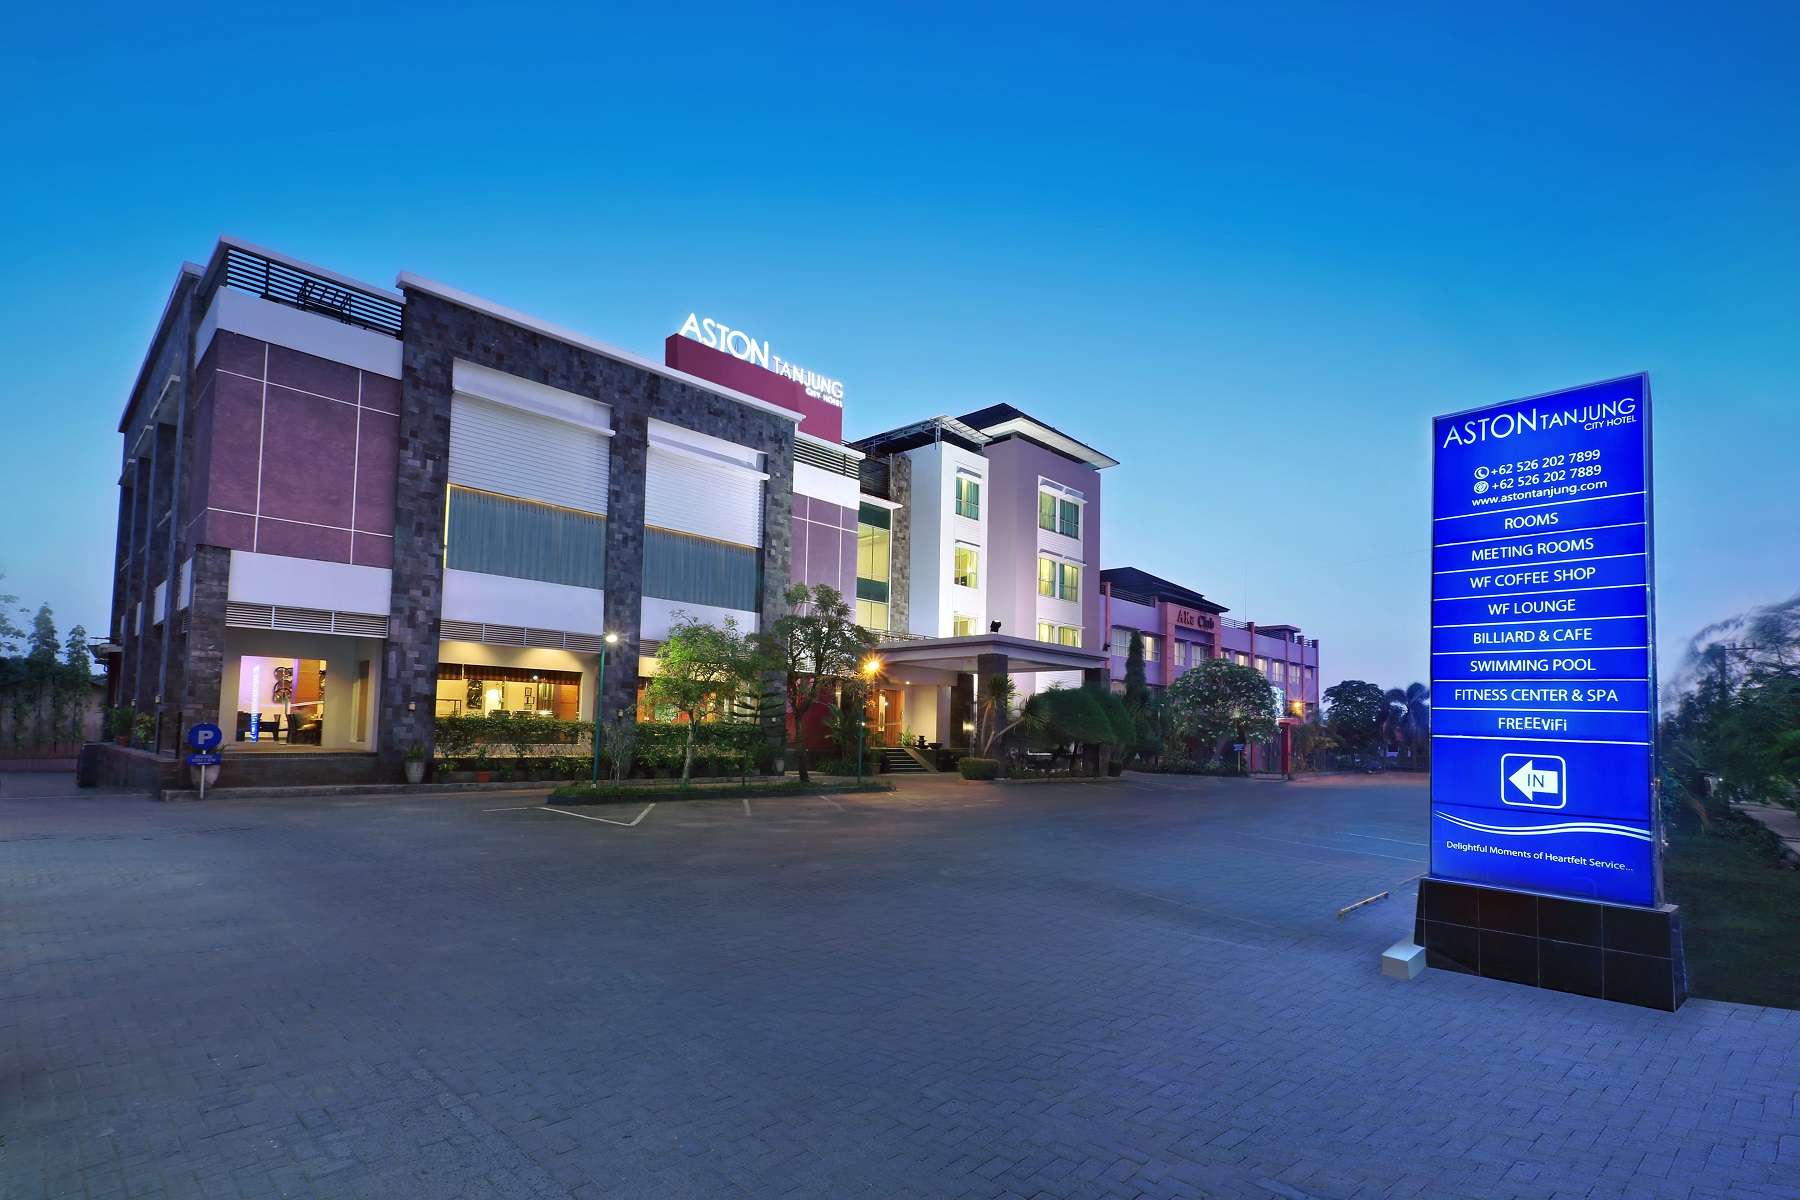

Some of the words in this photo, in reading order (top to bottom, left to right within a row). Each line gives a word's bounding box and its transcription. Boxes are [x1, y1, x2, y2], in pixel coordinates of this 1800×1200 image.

[679, 312, 769, 369] ASTON
[772, 355, 844, 398] TANJUNG
[1443, 408, 1537, 449] ASTON
[1539, 397, 1636, 431] TANJUNG
[1583, 420, 1605, 431] CITY
[1606, 414, 1637, 427] HOTEL
[1491, 463, 1513, 476] +62
[1517, 459, 1539, 472] 526
[1542, 454, 1565, 468] 202
[1569, 449, 1601, 464] 7899
[1492, 478, 1514, 491] +62
[1518, 473, 1540, 487] 526
[1543, 469, 1566, 483] 202
[1570, 464, 1602, 479] 7889
[1471, 479, 1608, 507] www.astontanjung.com
[1504, 512, 1559, 530] ROOMS
[1471, 544, 1534, 562] MEETING
[1537, 537, 1594, 554] ROOMS
[1470, 576, 1492, 589] WF
[1495, 571, 1549, 588] COFFEE
[1553, 567, 1596, 582] SHOP
[1488, 603, 1510, 616] WF
[1514, 599, 1576, 615] LOUNGE
[1473, 630, 1535, 644] BILLIARD
[1538, 629, 1550, 642] &
[1553, 628, 1593, 641] CAFE
[1470, 659, 1549, 672] SWIMMING
[1553, 658, 1596, 671] POOL
[1455, 689, 1508, 701] FITNESS
[1511, 689, 1568, 702] CENTER
[1571, 689, 1583, 702] &
[1587, 689, 1618, 702] SPA
[198, 730, 214, 745] P
[1527, 774, 1545, 788] IN
[1446, 841, 1488, 853] Delightful
[1490, 846, 1532, 859] Moments
[1533, 851, 1544, 860] of
[1545, 852, 1587, 866] Heartfelt
[1589, 858, 1633, 871] Service...
